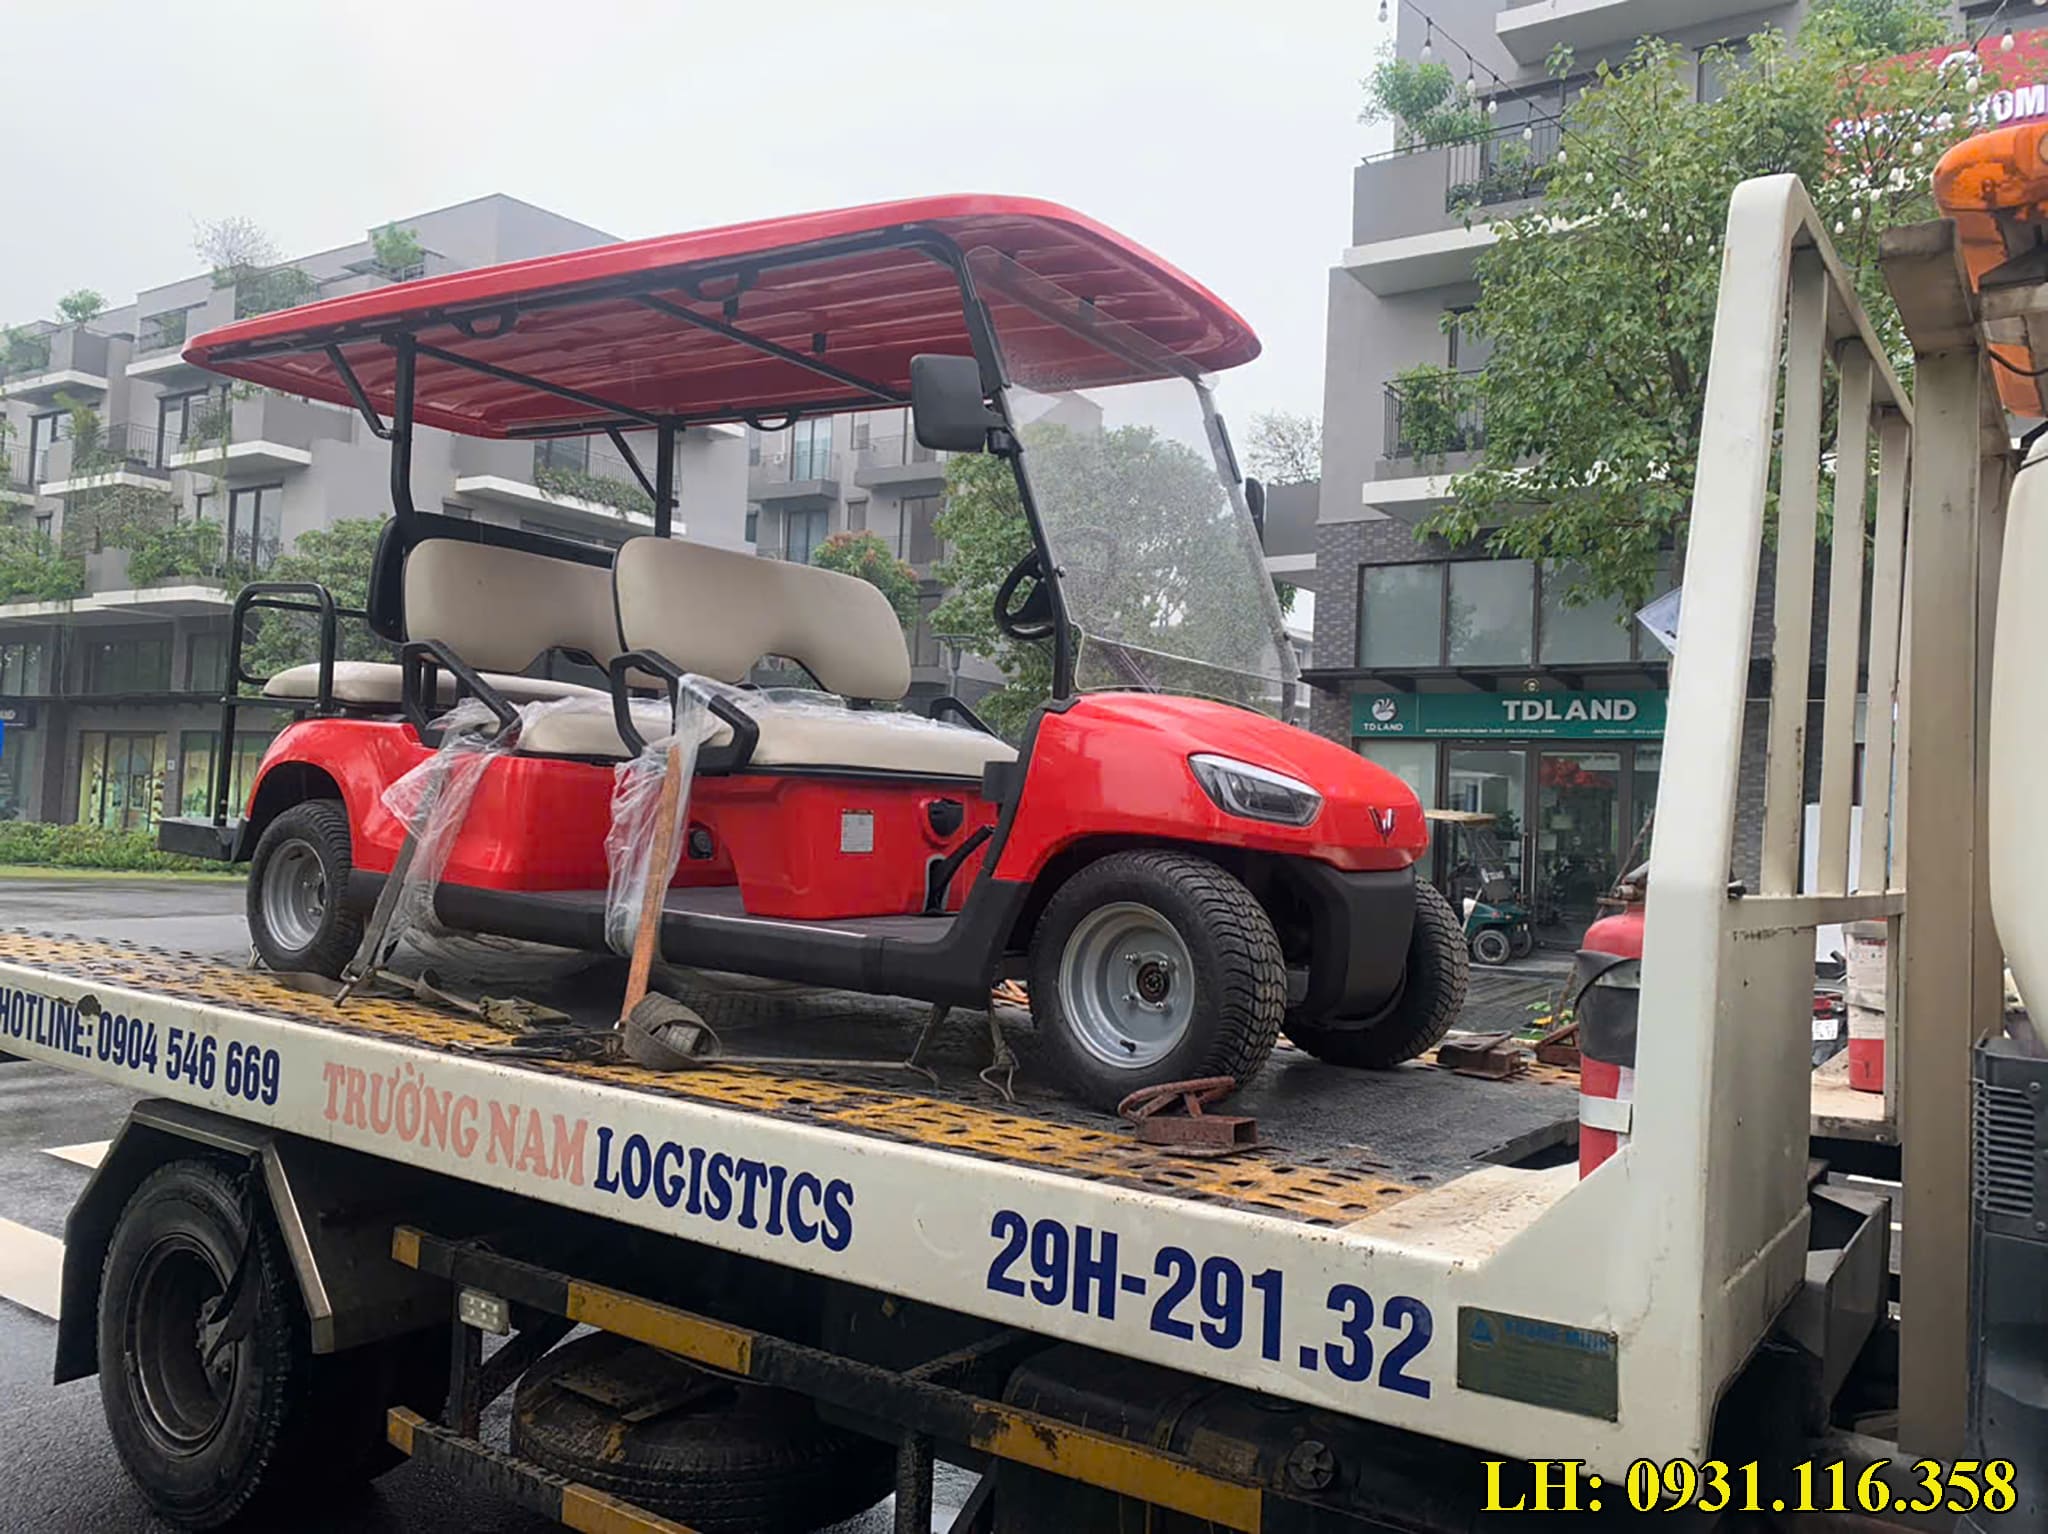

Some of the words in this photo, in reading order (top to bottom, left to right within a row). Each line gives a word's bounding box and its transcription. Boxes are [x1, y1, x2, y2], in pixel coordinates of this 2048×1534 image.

[1502, 699, 1637, 721] TDLAND
[0, 987, 93, 1058] HOTLINE:
[97, 1011, 158, 1074] 0904
[166, 1028, 217, 1090] 546
[224, 1039, 281, 1106] 669
[322, 1060, 481, 1164] TRƯỜNG
[486, 1101, 589, 1187] NAM
[594, 1127, 855, 1252] LOGISTICS
[986, 1210, 1433, 1400] 29H-291.32
